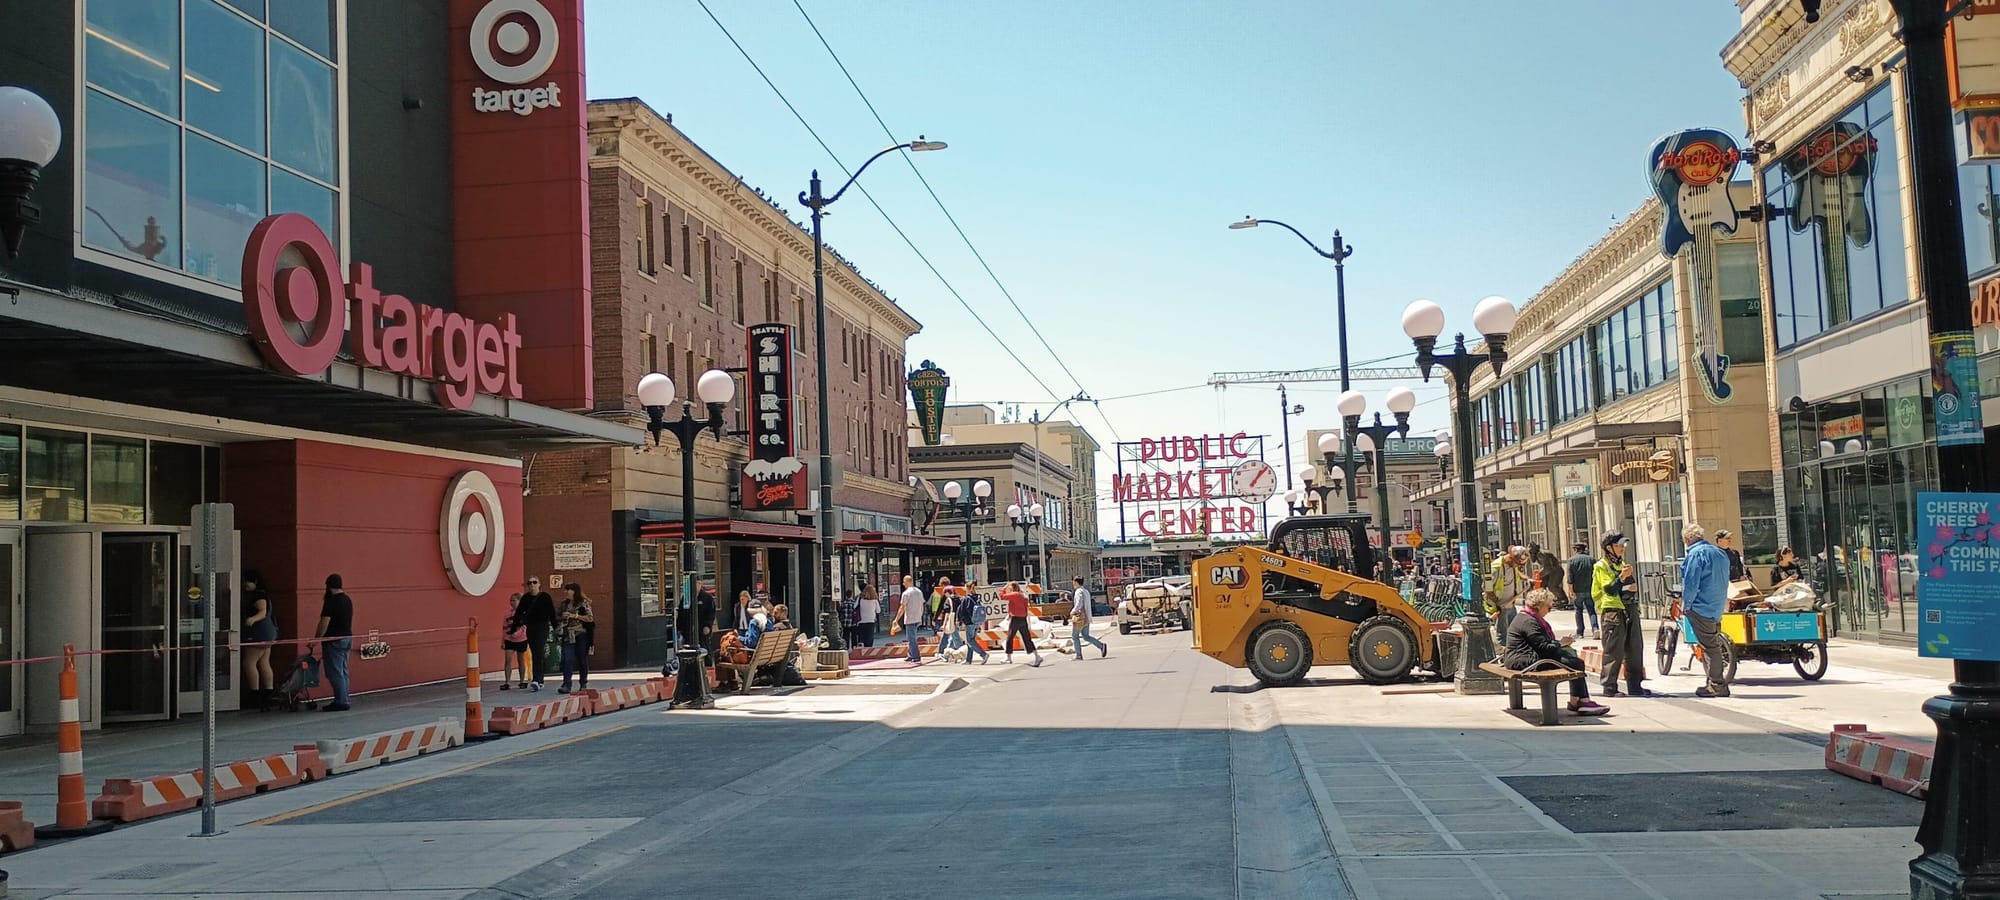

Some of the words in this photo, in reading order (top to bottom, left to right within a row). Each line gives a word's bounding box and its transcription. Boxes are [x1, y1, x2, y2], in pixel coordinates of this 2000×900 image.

[473, 83, 560, 115] target
[1662, 151, 1699, 169] Hard
[1703, 148, 1739, 167] Rock
[349, 262, 523, 410] target
[752, 326, 785, 335] SEATTLE
[759, 337, 781, 430] SHIRT
[924, 389, 937, 442] HOSTEL
[1141, 432, 1247, 463] PUBLIC
[1384, 441, 1399, 451] HE
[1621, 461, 1653, 470] LUKE'S
[1112, 469, 1232, 503] MARKET
[1926, 501, 1989, 513] CHERRY
[1138, 506, 1255, 536] CENTER
[1926, 515, 1977, 527] TREES
[1949, 546, 2000, 558] COMIN
[936, 557, 960, 567] Market
[1950, 560, 1986, 572] THIS
[1211, 567, 1241, 585] CAT
[978, 592, 1000, 603] ROA
[985, 604, 1008, 615] OSE
